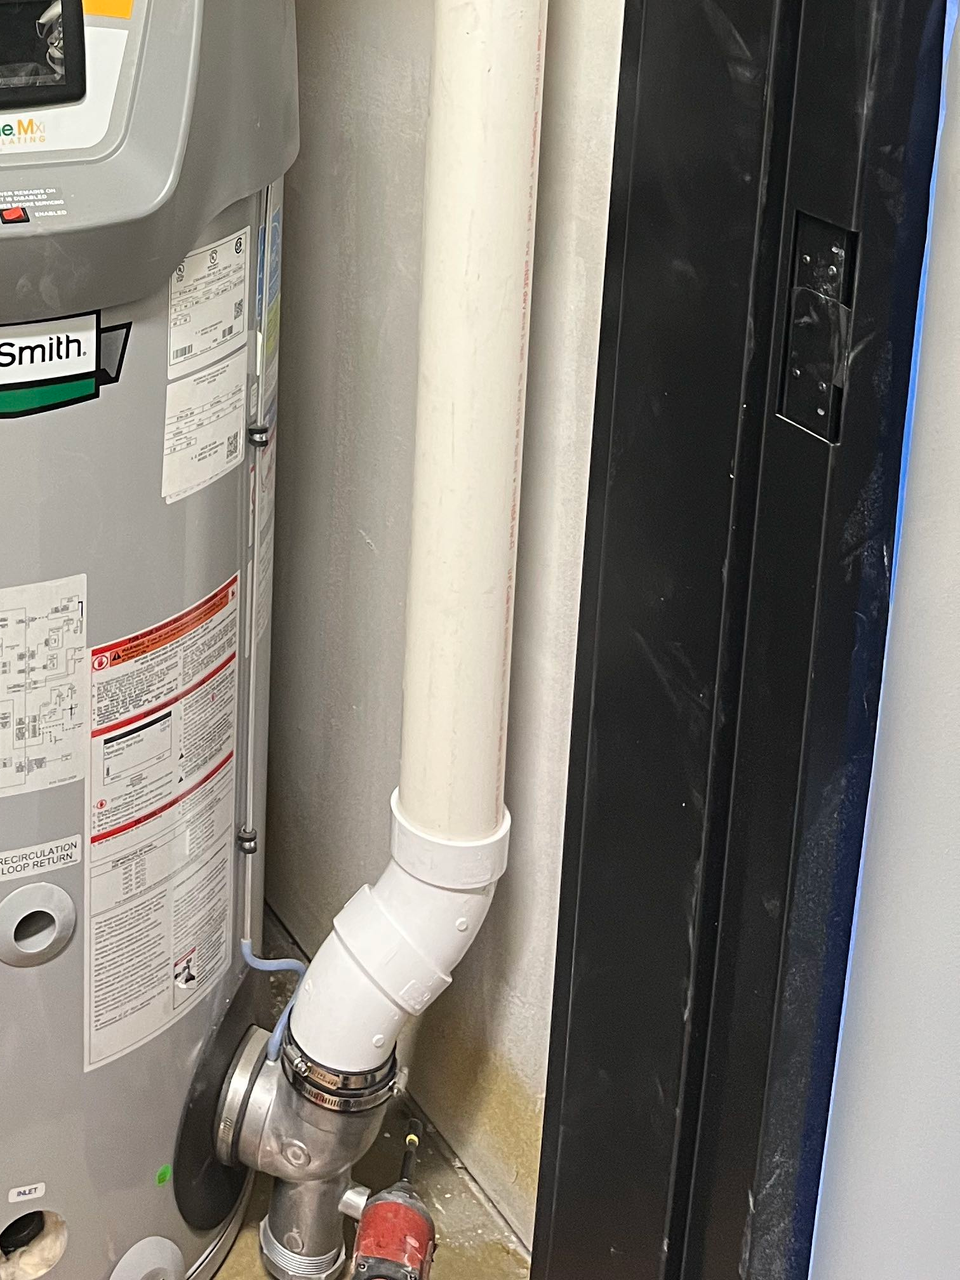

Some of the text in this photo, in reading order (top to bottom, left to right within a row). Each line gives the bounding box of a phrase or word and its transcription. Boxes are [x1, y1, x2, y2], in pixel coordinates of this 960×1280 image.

[1, 852, 73, 876] LOOP RETURN
[16, 1187, 38, 1197] INLET
